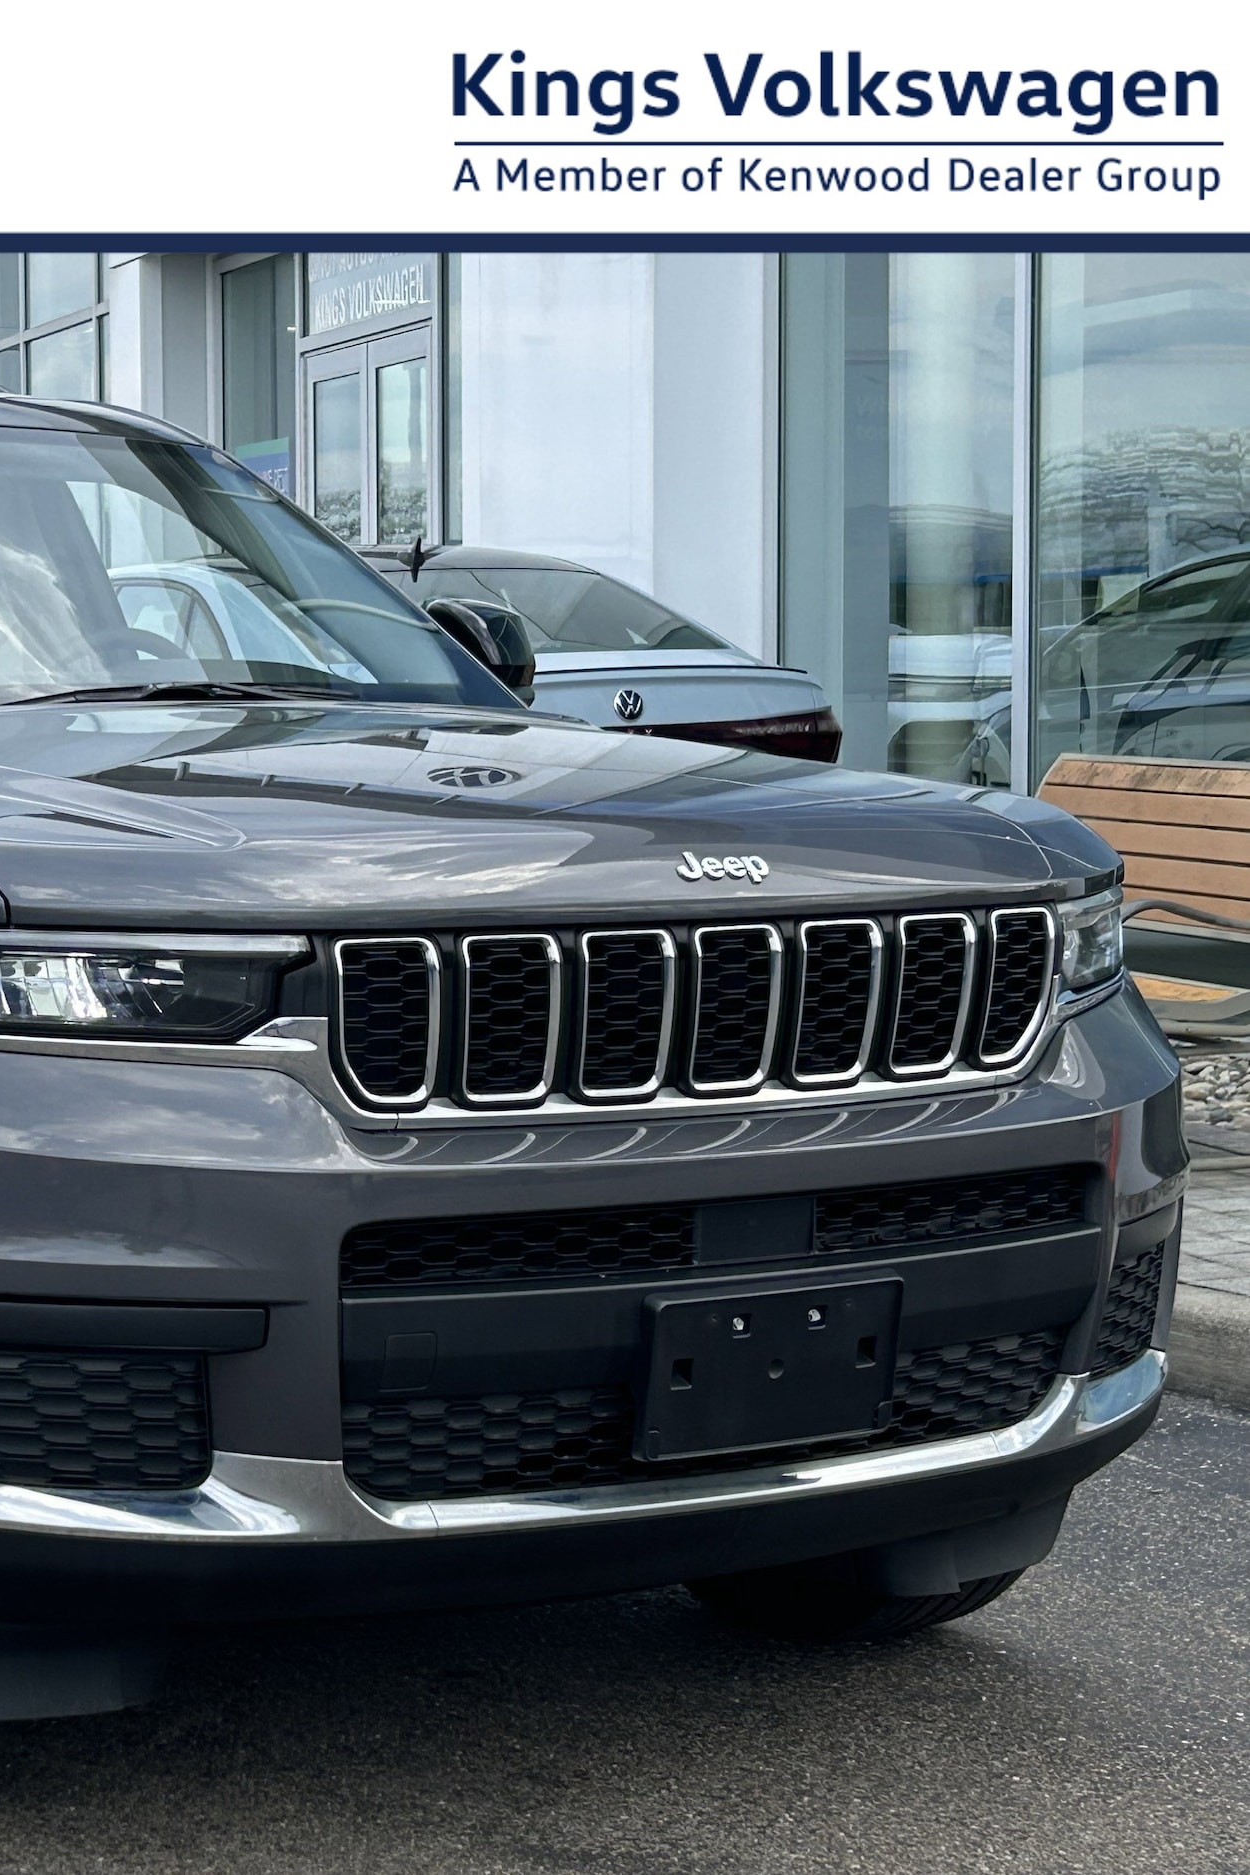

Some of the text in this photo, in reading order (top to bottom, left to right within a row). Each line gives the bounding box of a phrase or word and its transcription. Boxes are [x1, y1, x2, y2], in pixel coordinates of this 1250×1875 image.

[314, 286, 346, 331] KINGS
[347, 263, 425, 321] VOLKSWAGEN
[676, 851, 770, 885] Jeep
